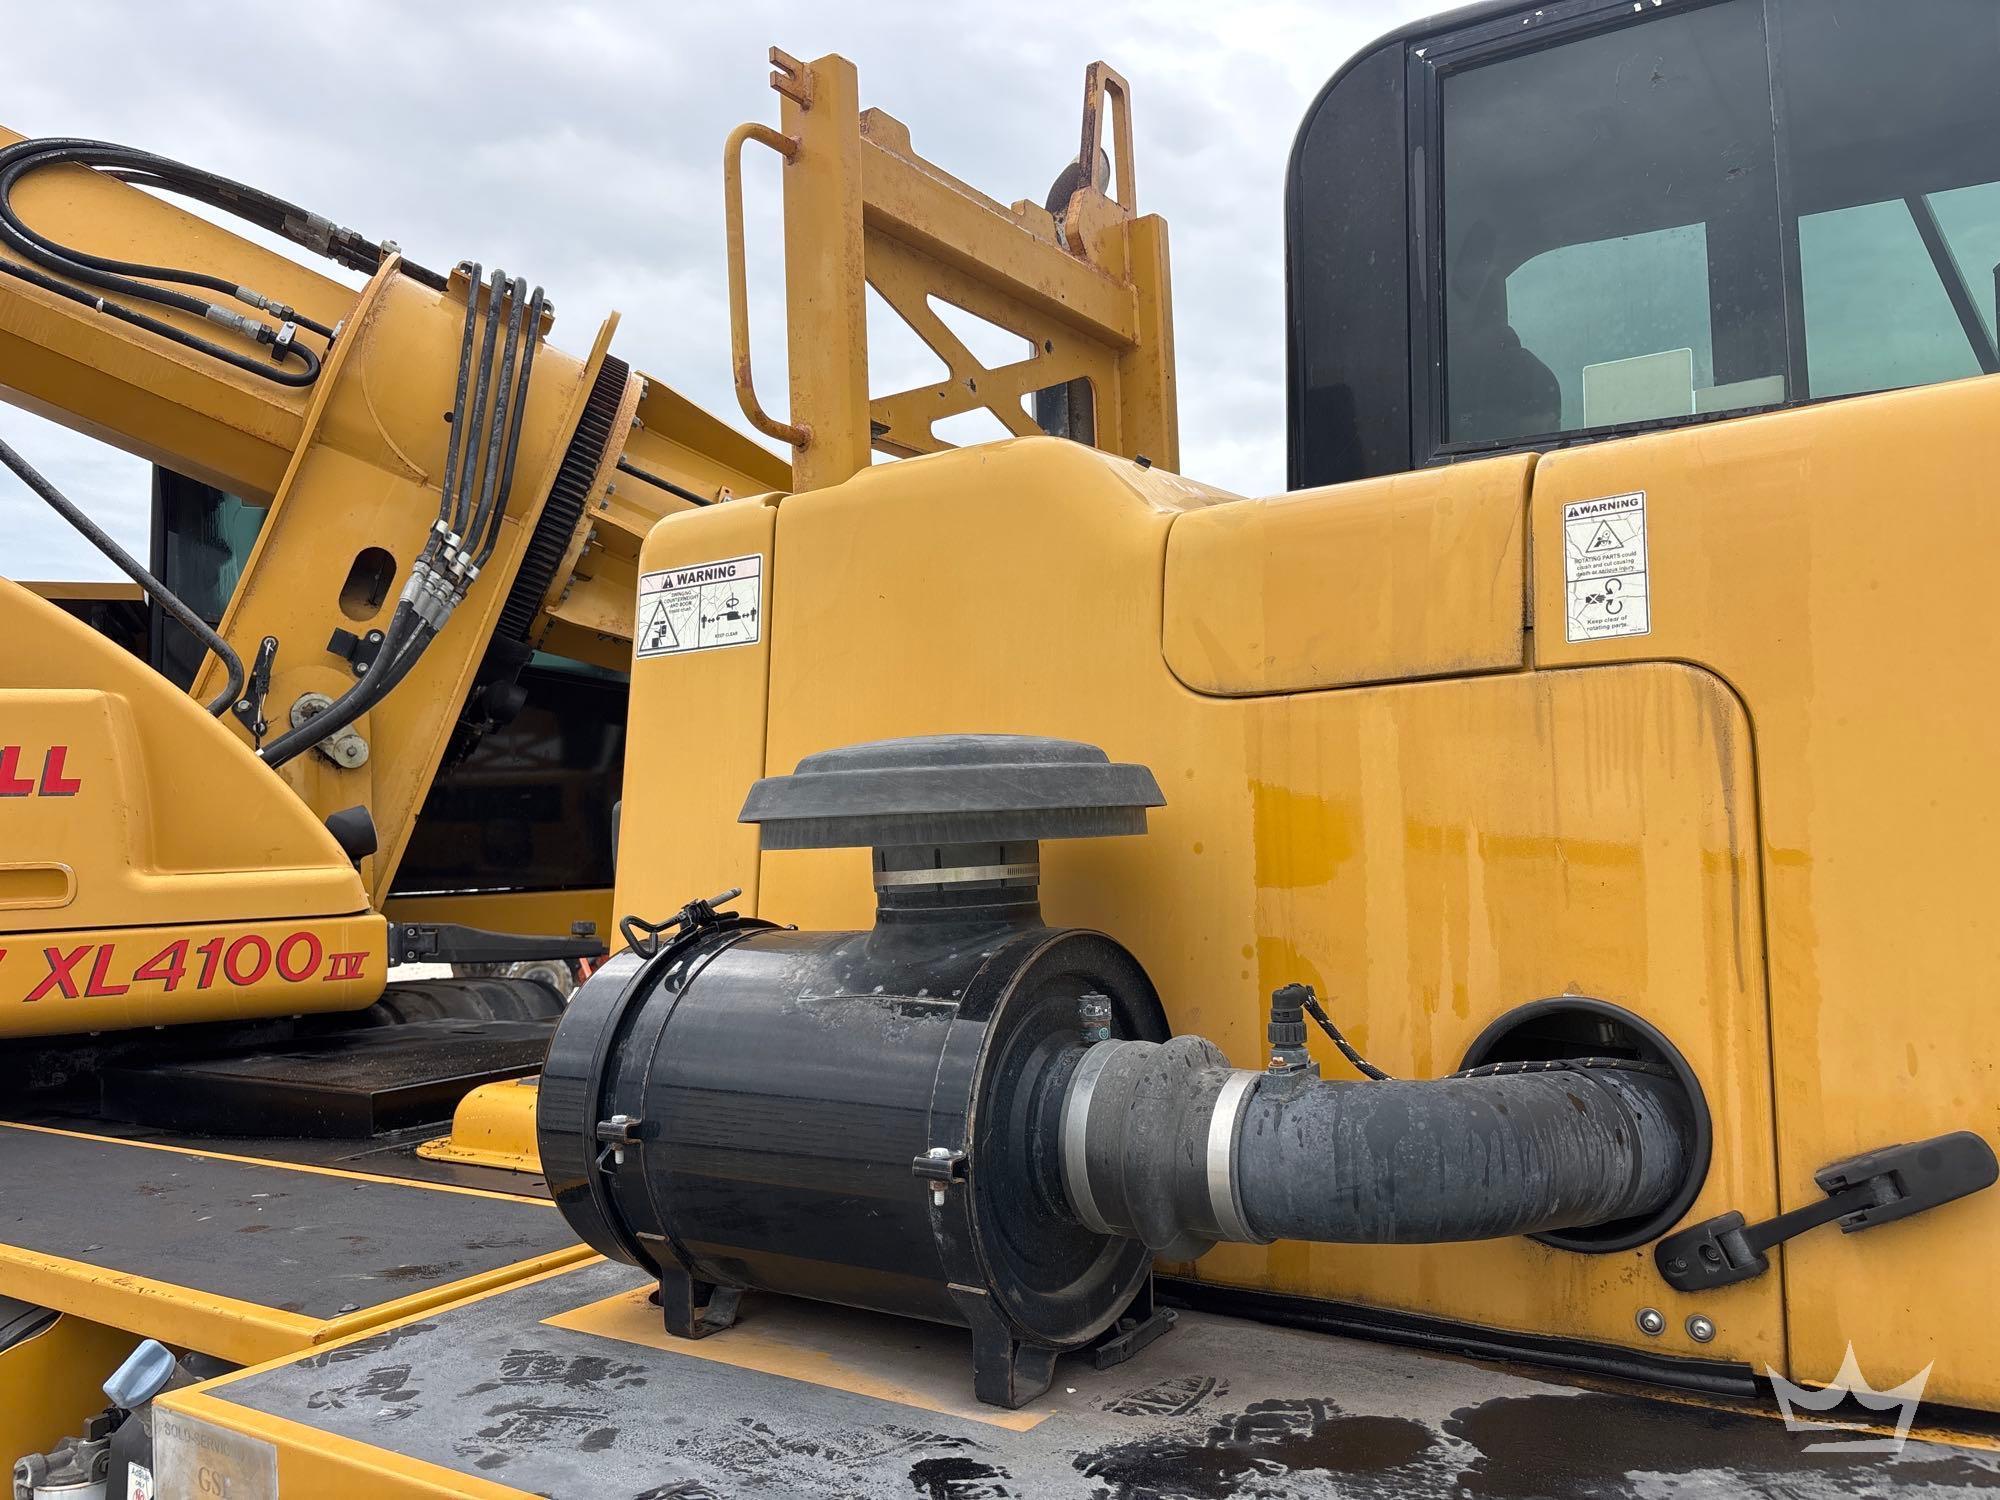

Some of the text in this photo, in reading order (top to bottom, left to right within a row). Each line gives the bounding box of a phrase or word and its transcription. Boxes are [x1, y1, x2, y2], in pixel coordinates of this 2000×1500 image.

[1580, 498, 1639, 515] WARNING
[1602, 553, 1621, 561] PARTS
[1621, 550, 1637, 558] could
[1613, 558, 1635, 566] causing
[677, 565, 736, 586] WARNING
[1587, 618, 1603, 626] Keep
[1586, 624, 1610, 632] rotating
[23, 931, 323, 1003] XL4100
